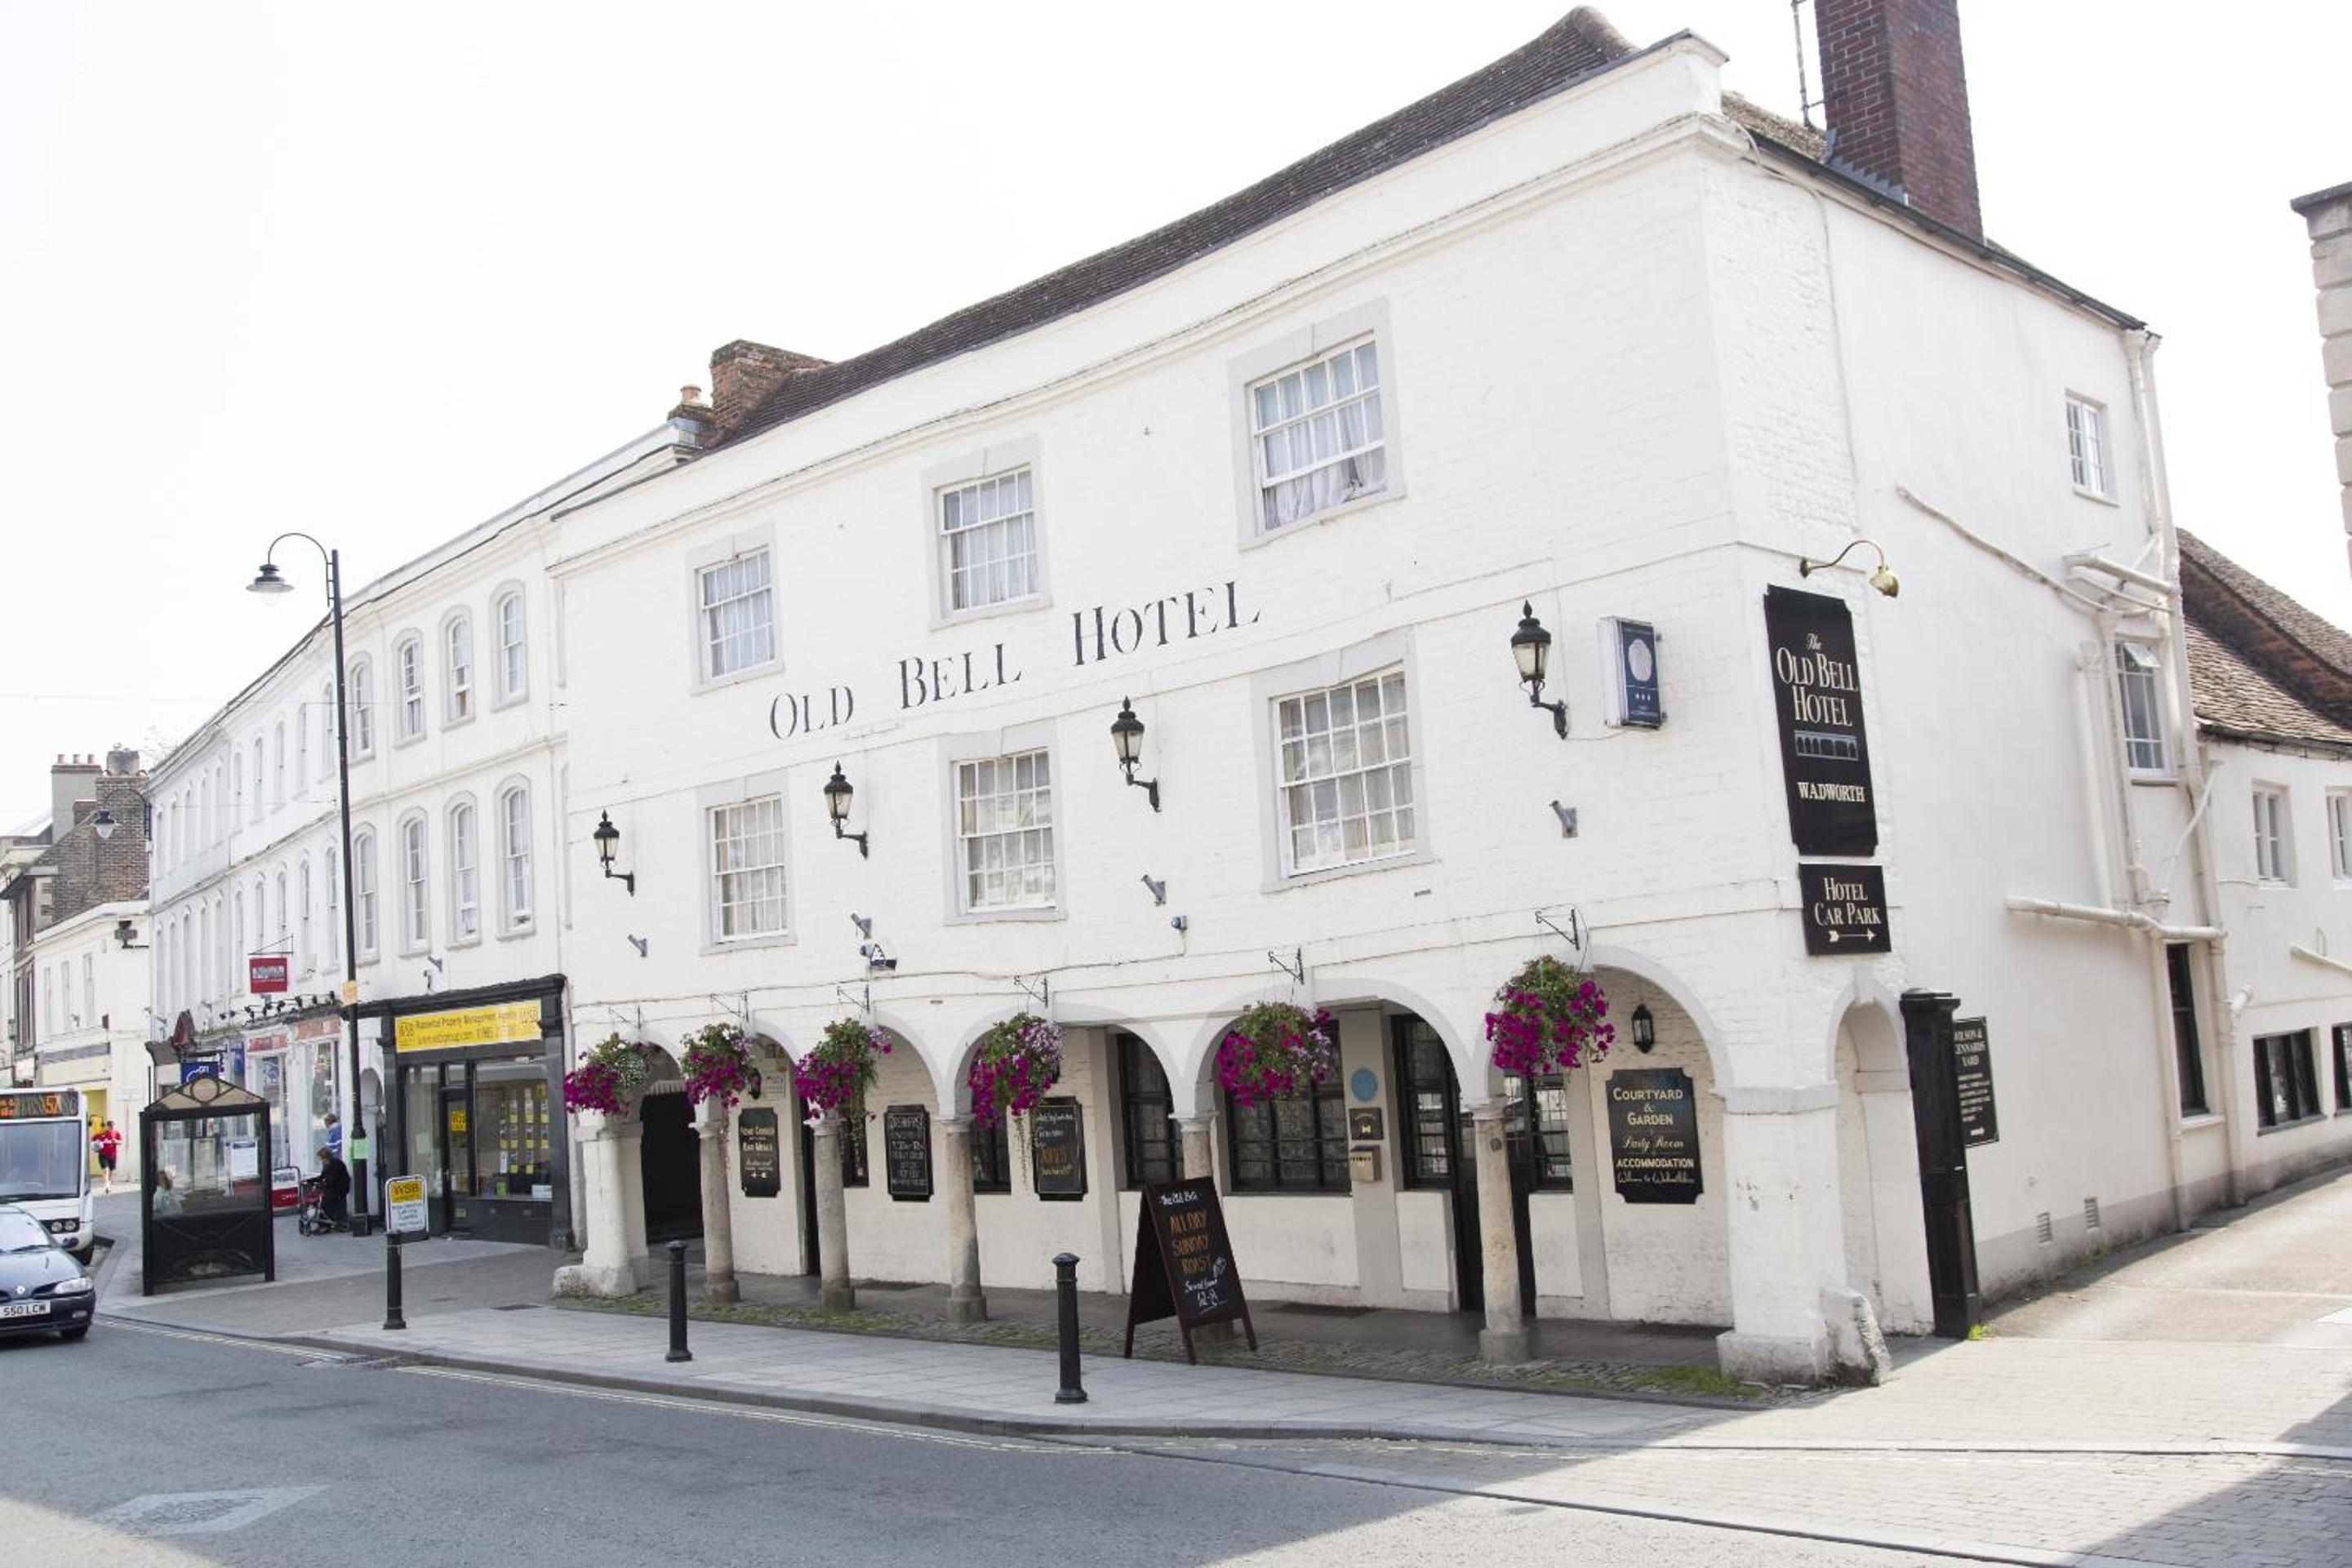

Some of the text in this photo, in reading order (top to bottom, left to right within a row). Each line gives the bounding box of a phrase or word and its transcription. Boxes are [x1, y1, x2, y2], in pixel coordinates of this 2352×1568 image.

[1807, 633, 1823, 651] The
[770, 580, 1261, 740] OLD BELL HOTEL
[1776, 646, 1859, 692] OLD BELL
[1792, 684, 1853, 727] HOTEL
[1798, 782, 1866, 803] WADWORTH
[1823, 877, 1868, 901] HOTEL
[1814, 902, 1881, 926] CAR PARK
[1612, 1087, 1683, 1100] COURTYARD
[1643, 1103, 1655, 1113] &
[1627, 1112, 1674, 1126] GARDEN
[1616, 1157, 1695, 1168] ACCOMMODATION
